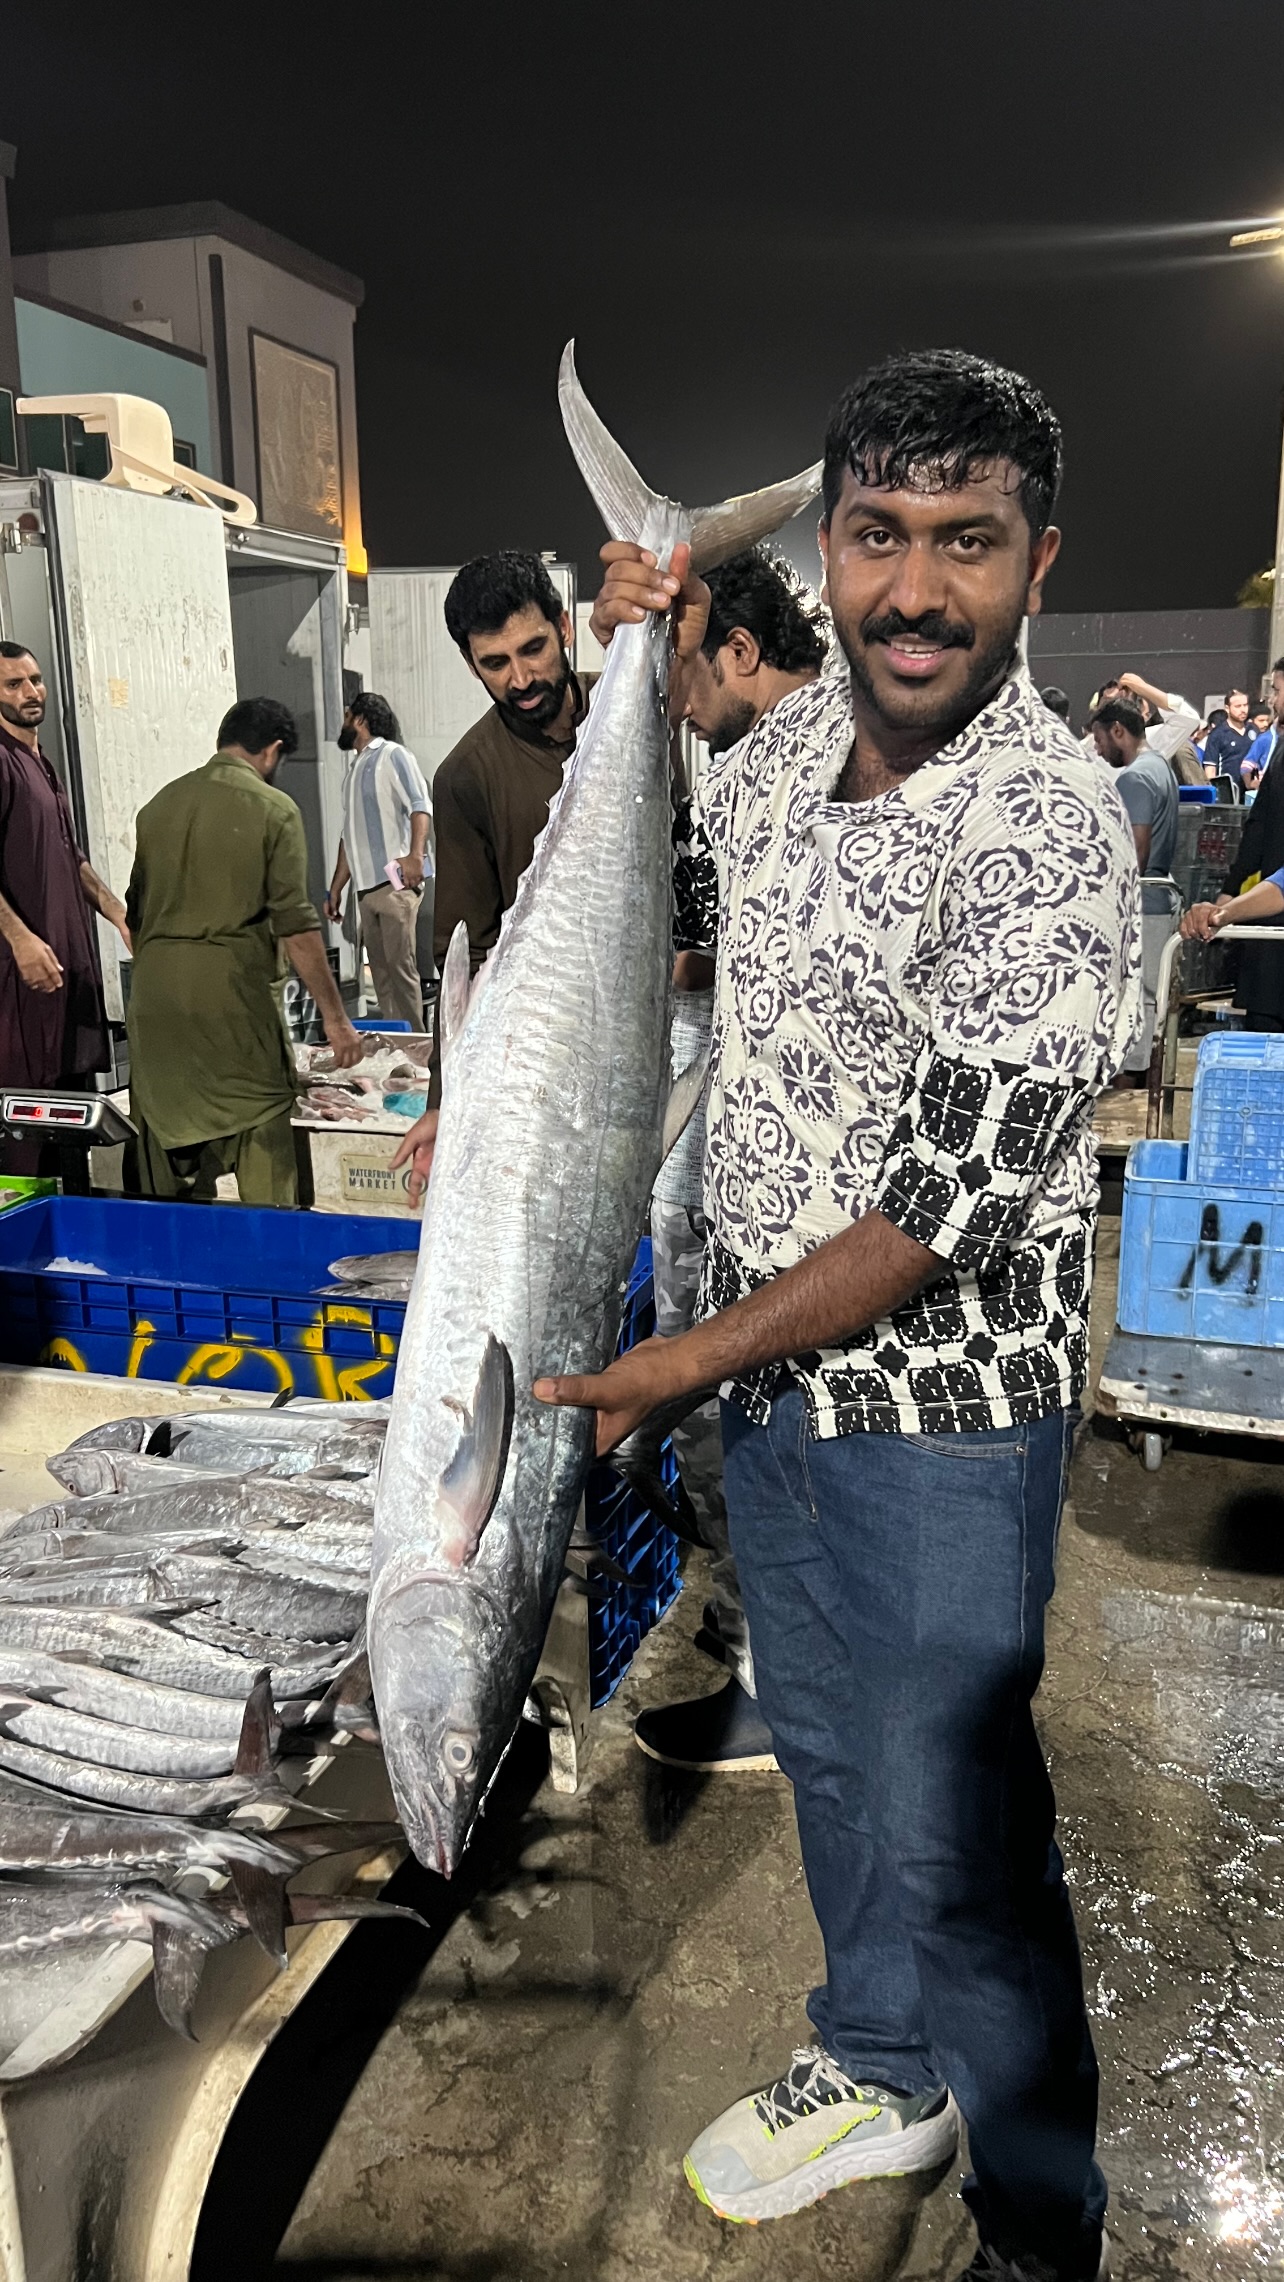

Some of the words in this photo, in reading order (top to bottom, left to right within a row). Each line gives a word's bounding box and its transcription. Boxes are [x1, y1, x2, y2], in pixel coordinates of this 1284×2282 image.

[349, 1168, 396, 1180] WATERFRONT
[349, 1177, 396, 1190] MARKET
[1178, 1203, 1263, 1306] M
